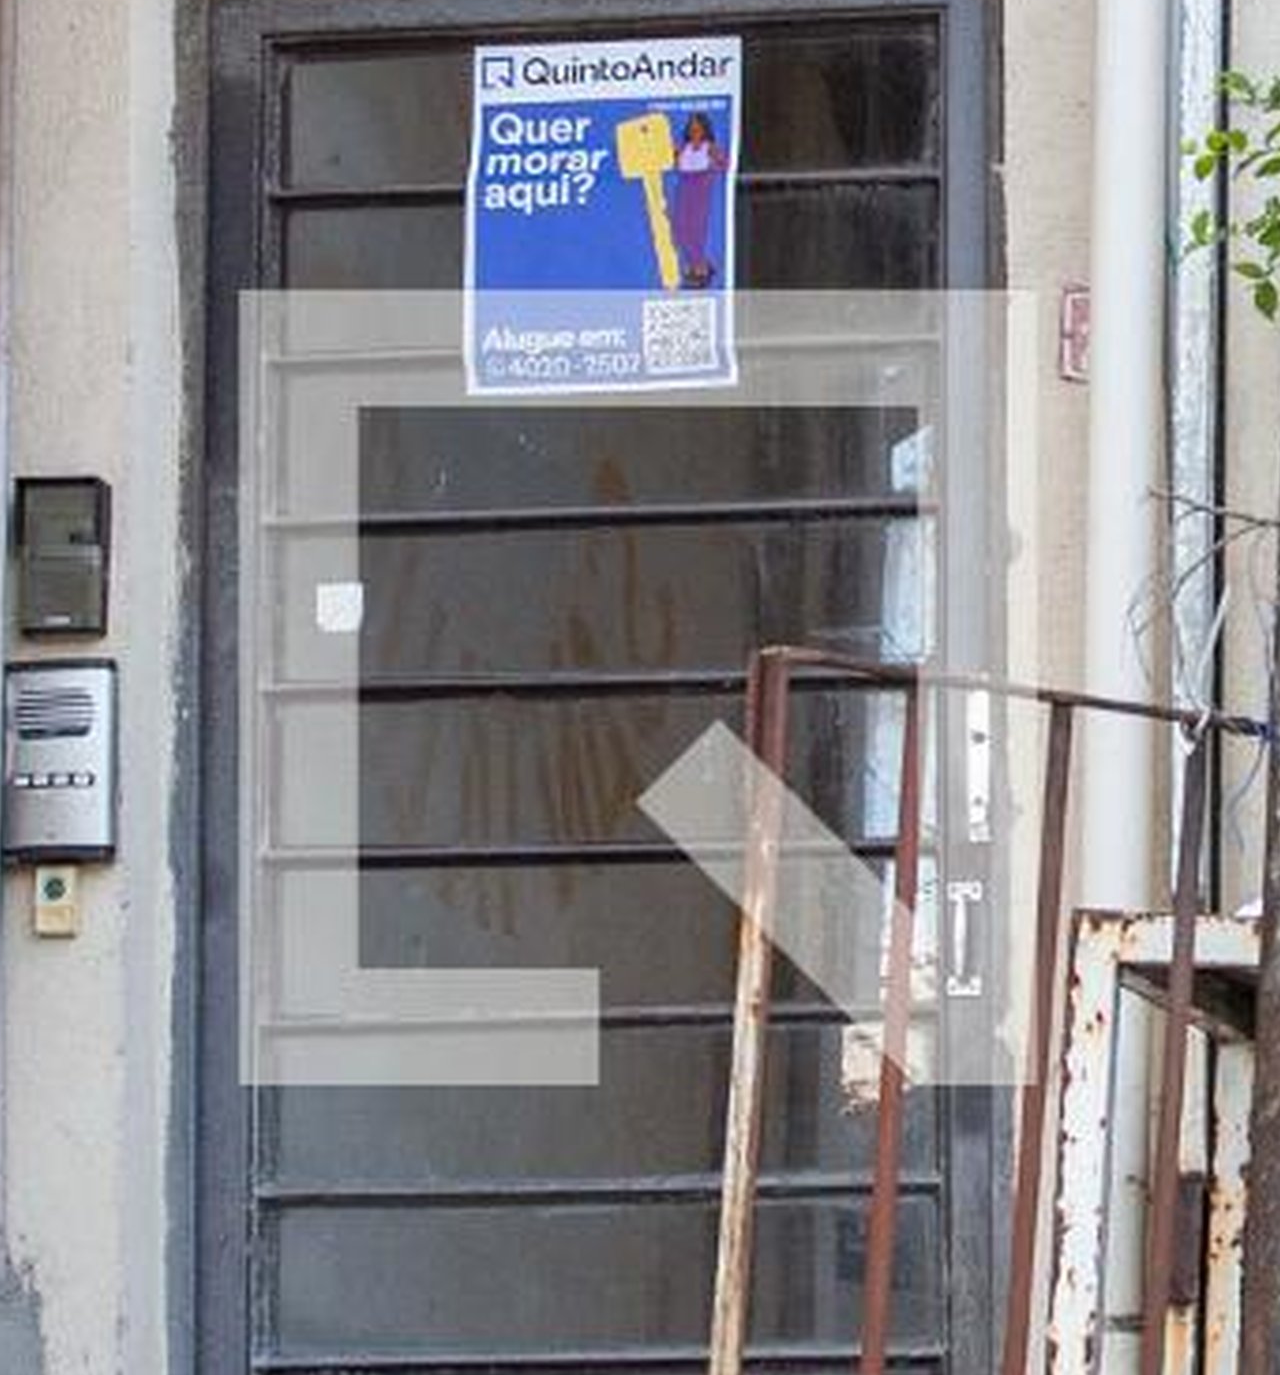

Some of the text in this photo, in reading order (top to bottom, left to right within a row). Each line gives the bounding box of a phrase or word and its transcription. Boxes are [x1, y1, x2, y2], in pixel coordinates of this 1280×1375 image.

[522, 52, 734, 85] QuintoAndar
[489, 112, 592, 146] Quer
[486, 148, 609, 176] morar
[484, 172, 597, 216] aqui?
[481, 324, 627, 355] Alugue em:
